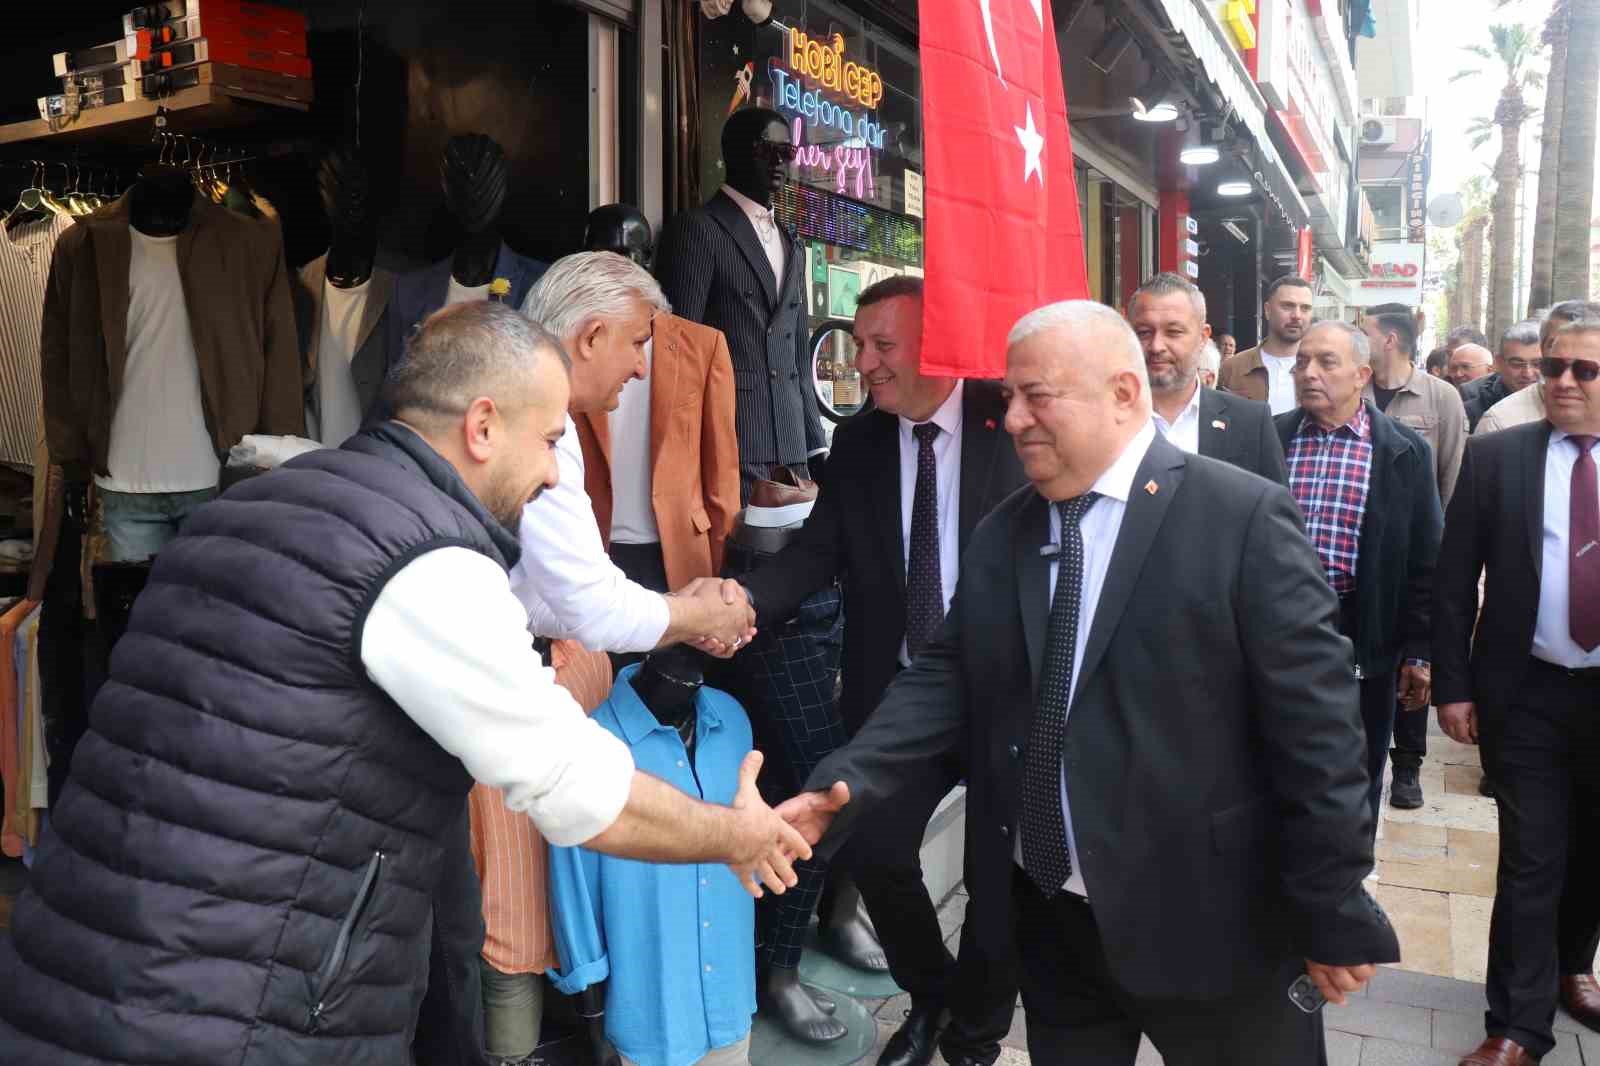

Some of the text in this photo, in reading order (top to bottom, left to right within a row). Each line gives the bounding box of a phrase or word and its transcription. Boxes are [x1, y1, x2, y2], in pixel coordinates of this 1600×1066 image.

[773, 68, 887, 149] Telefona dair
[844, 62, 882, 109] CEP
[792, 117, 831, 170] her
